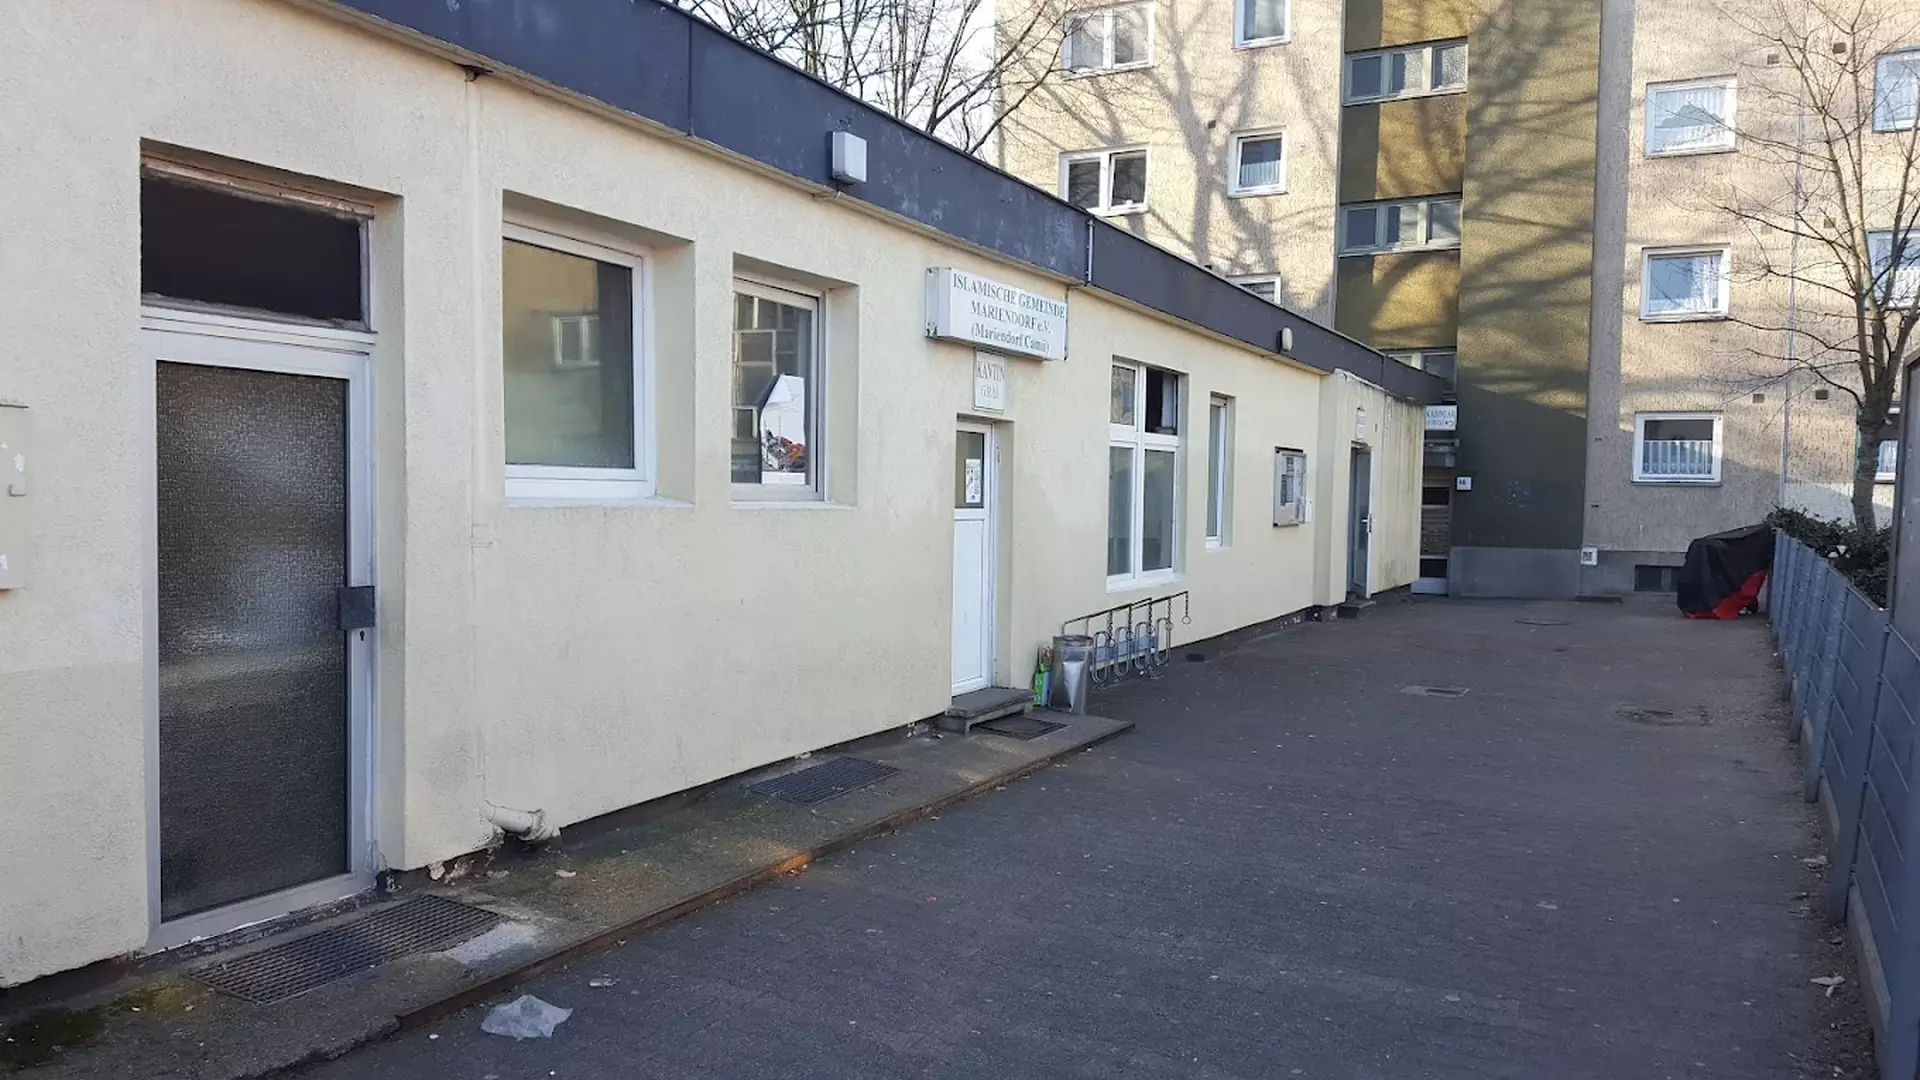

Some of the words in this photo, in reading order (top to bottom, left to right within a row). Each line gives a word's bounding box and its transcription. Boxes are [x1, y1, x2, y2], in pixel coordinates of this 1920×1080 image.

[953, 273, 1017, 305] ISLAMISCHE
[1019, 292, 1066, 319] GEMEINDE
[970, 300, 1037, 330] MARIENDORF
[970, 322, 1024, 348] (Mariendorf
